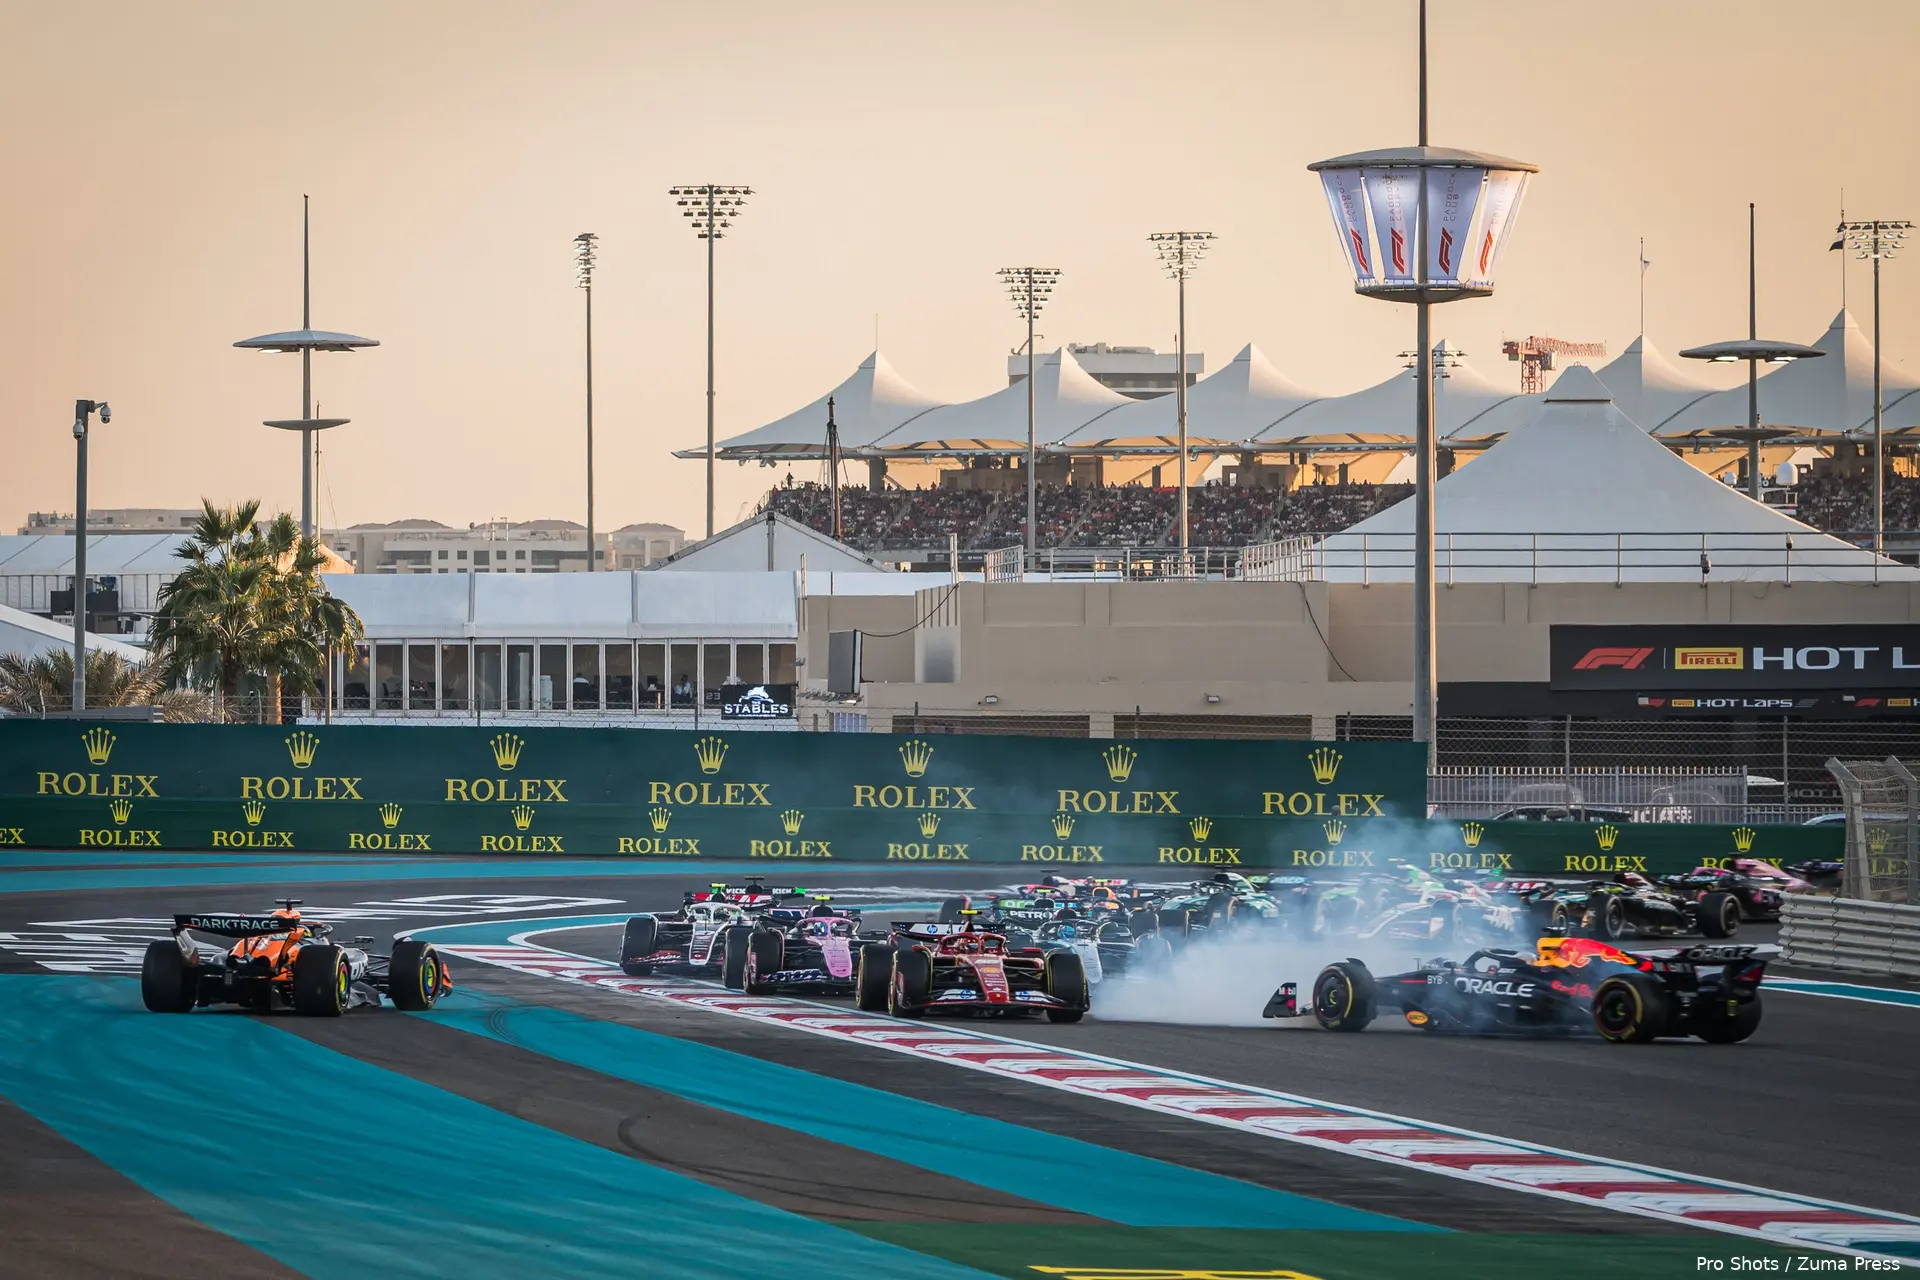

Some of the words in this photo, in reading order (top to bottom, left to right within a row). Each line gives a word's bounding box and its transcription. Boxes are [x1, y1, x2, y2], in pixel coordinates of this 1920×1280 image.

[1443, 172, 1456, 222] PADDOCK
[1450, 193, 1460, 222] CLUB
[1681, 652, 1737, 665] PIRELLI
[1753, 647, 1880, 670] HOT
[724, 703, 789, 714] STABLES
[1696, 699, 1740, 708] HOT
[37, 772, 160, 798] ROLEX
[241, 776, 364, 800] ROLEX
[445, 779, 569, 803] ROLEX
[648, 782, 772, 806] ROLEX
[853, 784, 977, 809] ROLEX
[1057, 788, 1181, 814] ROLEX
[1261, 791, 1386, 817] ROLEX
[80, 829, 162, 847] ROLEX
[212, 831, 295, 848] ROLEX
[349, 833, 432, 850] ROLEX
[481, 835, 564, 852] ROLEX
[617, 837, 700, 855] ROLEX
[750, 839, 833, 857] ROLEX
[886, 842, 969, 860] ROLEX
[1021, 844, 1104, 862] ROLEX
[1158, 847, 1242, 864] ROLEX
[1292, 849, 1375, 867] ROLEX
[1429, 852, 1513, 870] ROLEX
[1564, 855, 1648, 872] ROLEX
[191, 918, 280, 930] DARKTRACE
[1454, 976, 1536, 998] ORACLE
